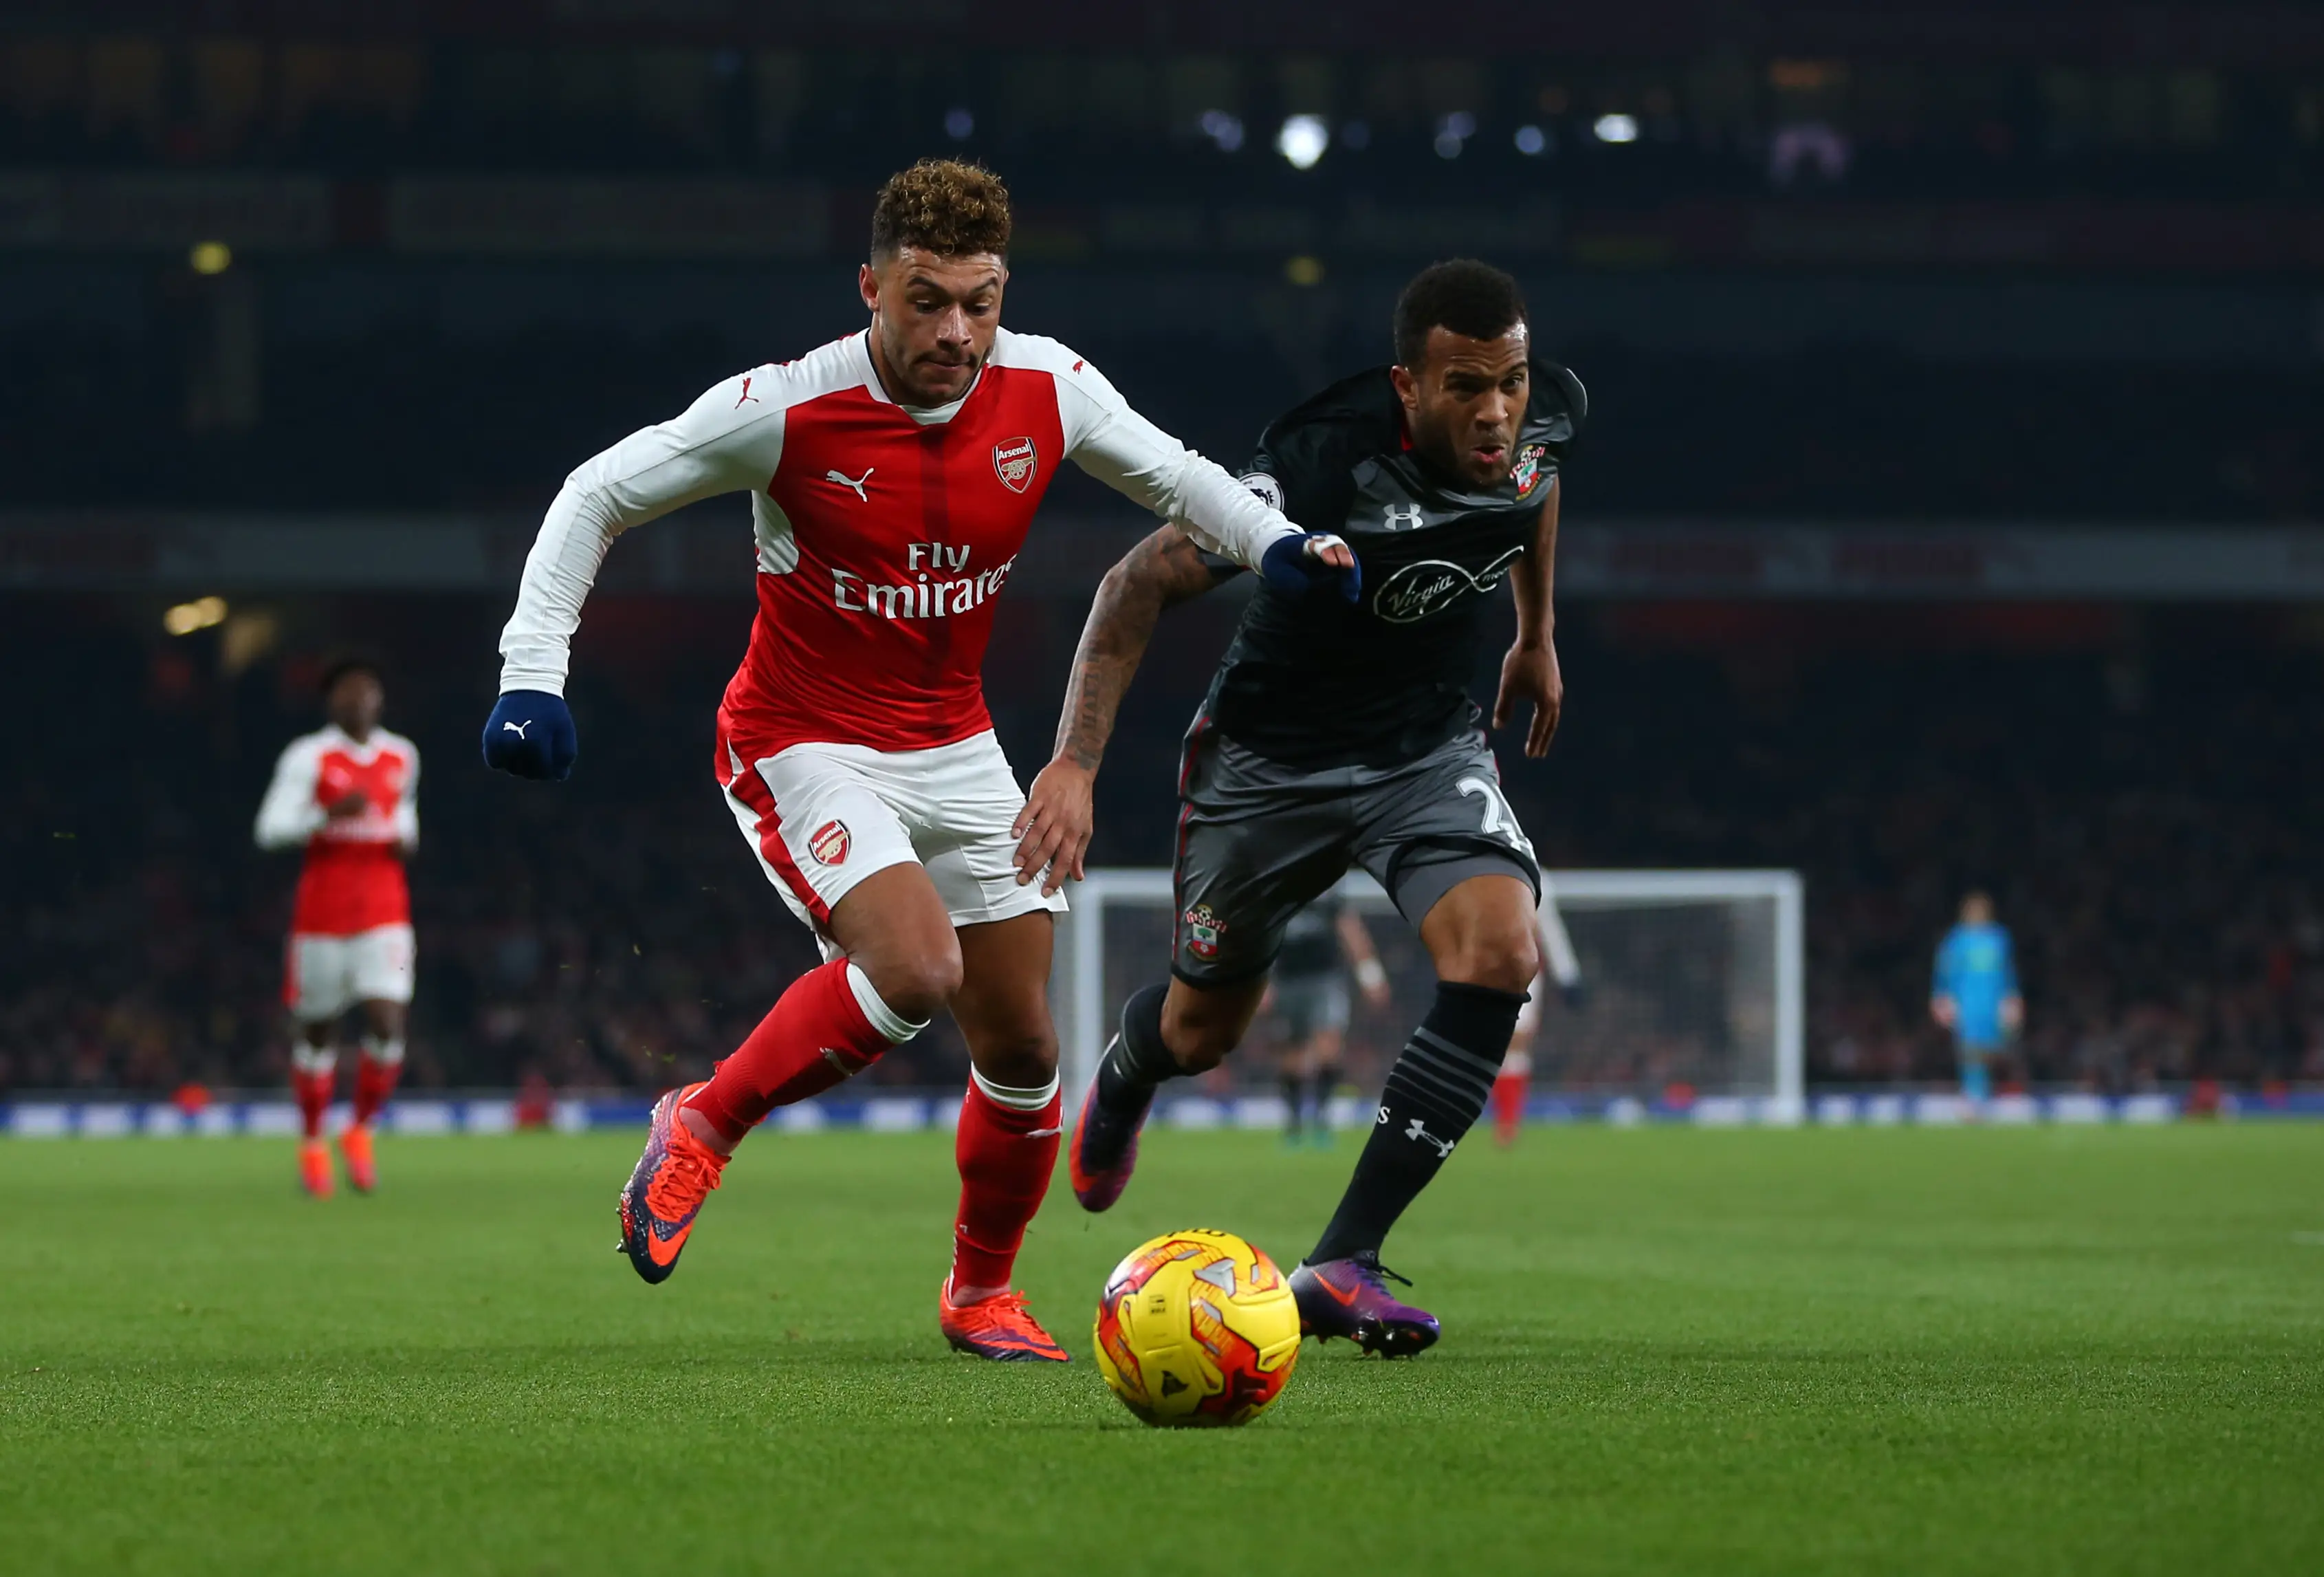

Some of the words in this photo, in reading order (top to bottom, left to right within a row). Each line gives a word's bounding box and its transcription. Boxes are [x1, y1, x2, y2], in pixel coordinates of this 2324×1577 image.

[998, 444, 1030, 460] Arsenal
[908, 542, 970, 573] Fly
[1388, 574, 1455, 615] Virgin
[813, 825, 841, 851] Arsenal
